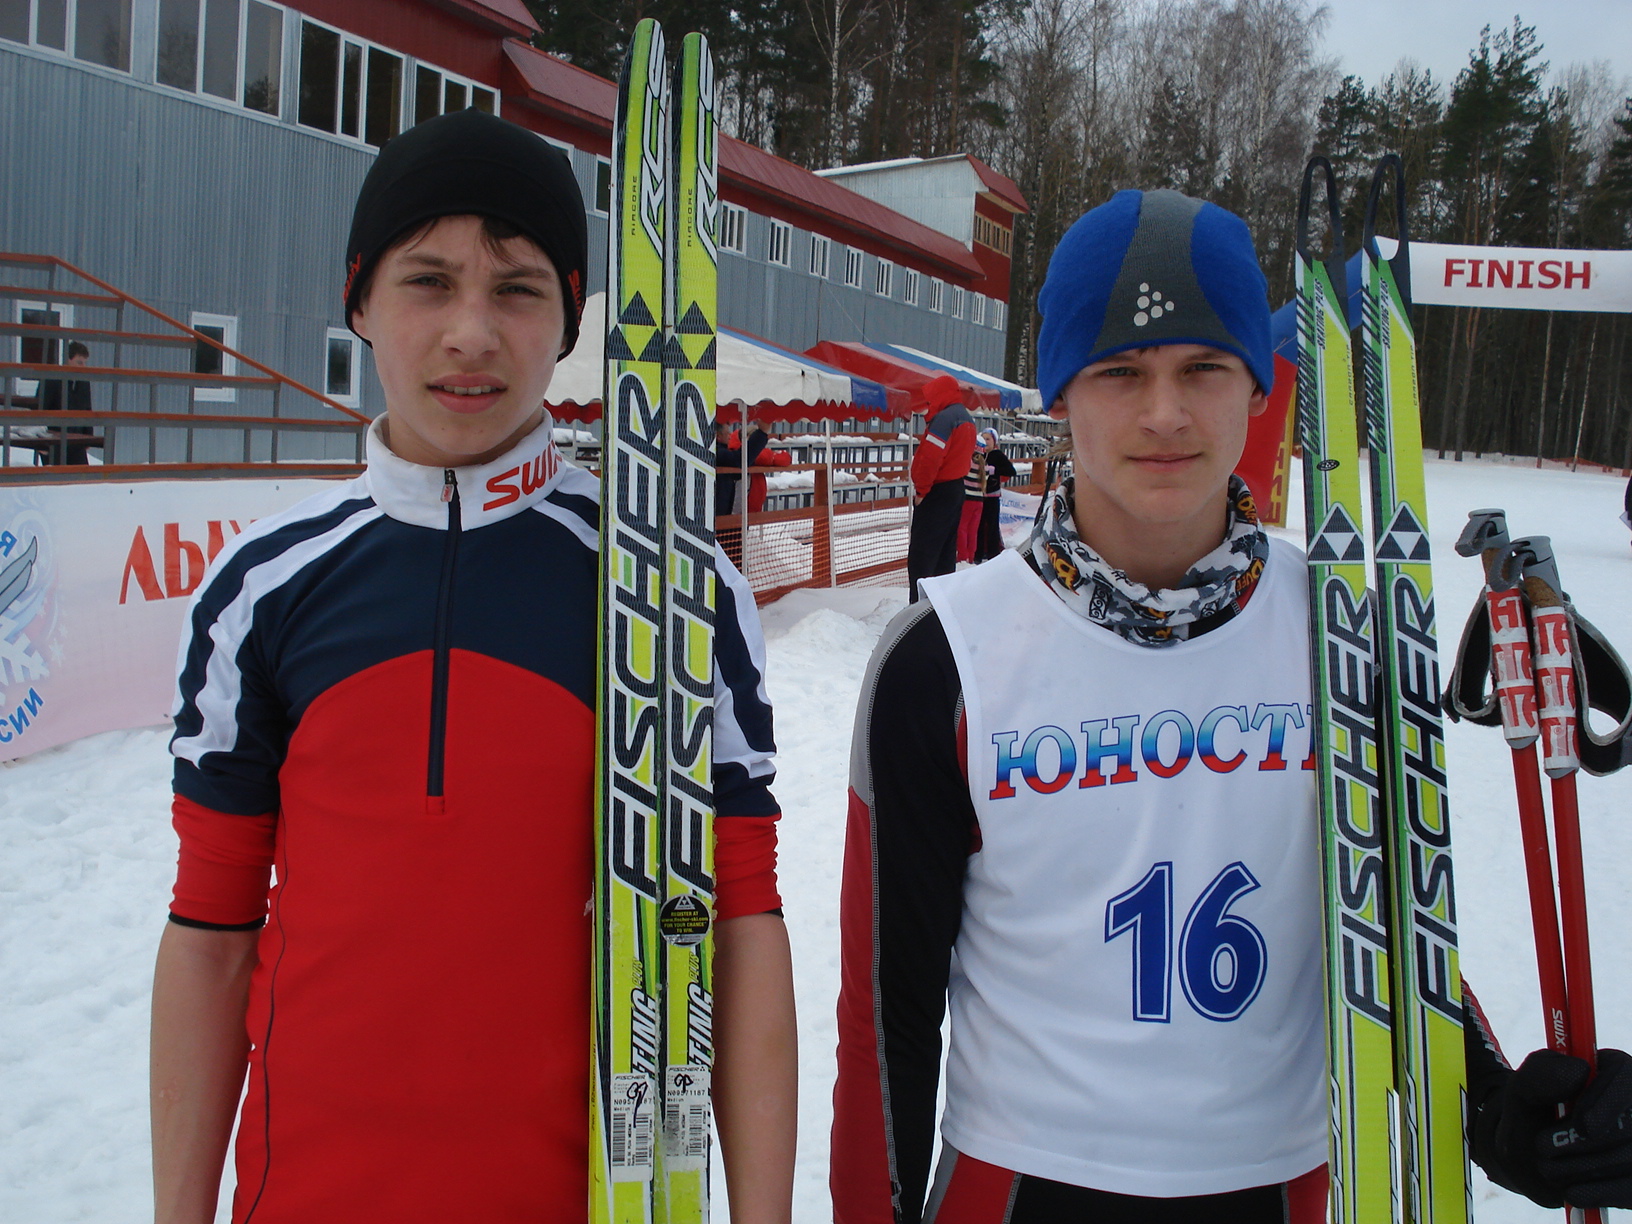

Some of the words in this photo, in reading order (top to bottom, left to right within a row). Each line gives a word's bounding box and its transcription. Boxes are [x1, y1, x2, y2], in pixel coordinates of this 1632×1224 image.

[640, 20, 667, 261] RCS
[696, 34, 719, 267] RCS
[1380, 277, 1390, 305] PLUS
[1380, 306, 1391, 350] SKATING
[1443, 258, 1591, 290] FINISH
[118, 519, 259, 606] ЛЫ
[612, 373, 661, 898] FISCHER
[669, 381, 717, 896] FISCHER
[1325, 577, 1391, 1027] FISCHER
[1394, 576, 1465, 1025] FISCHER
[1104, 861, 1268, 1024] 16
